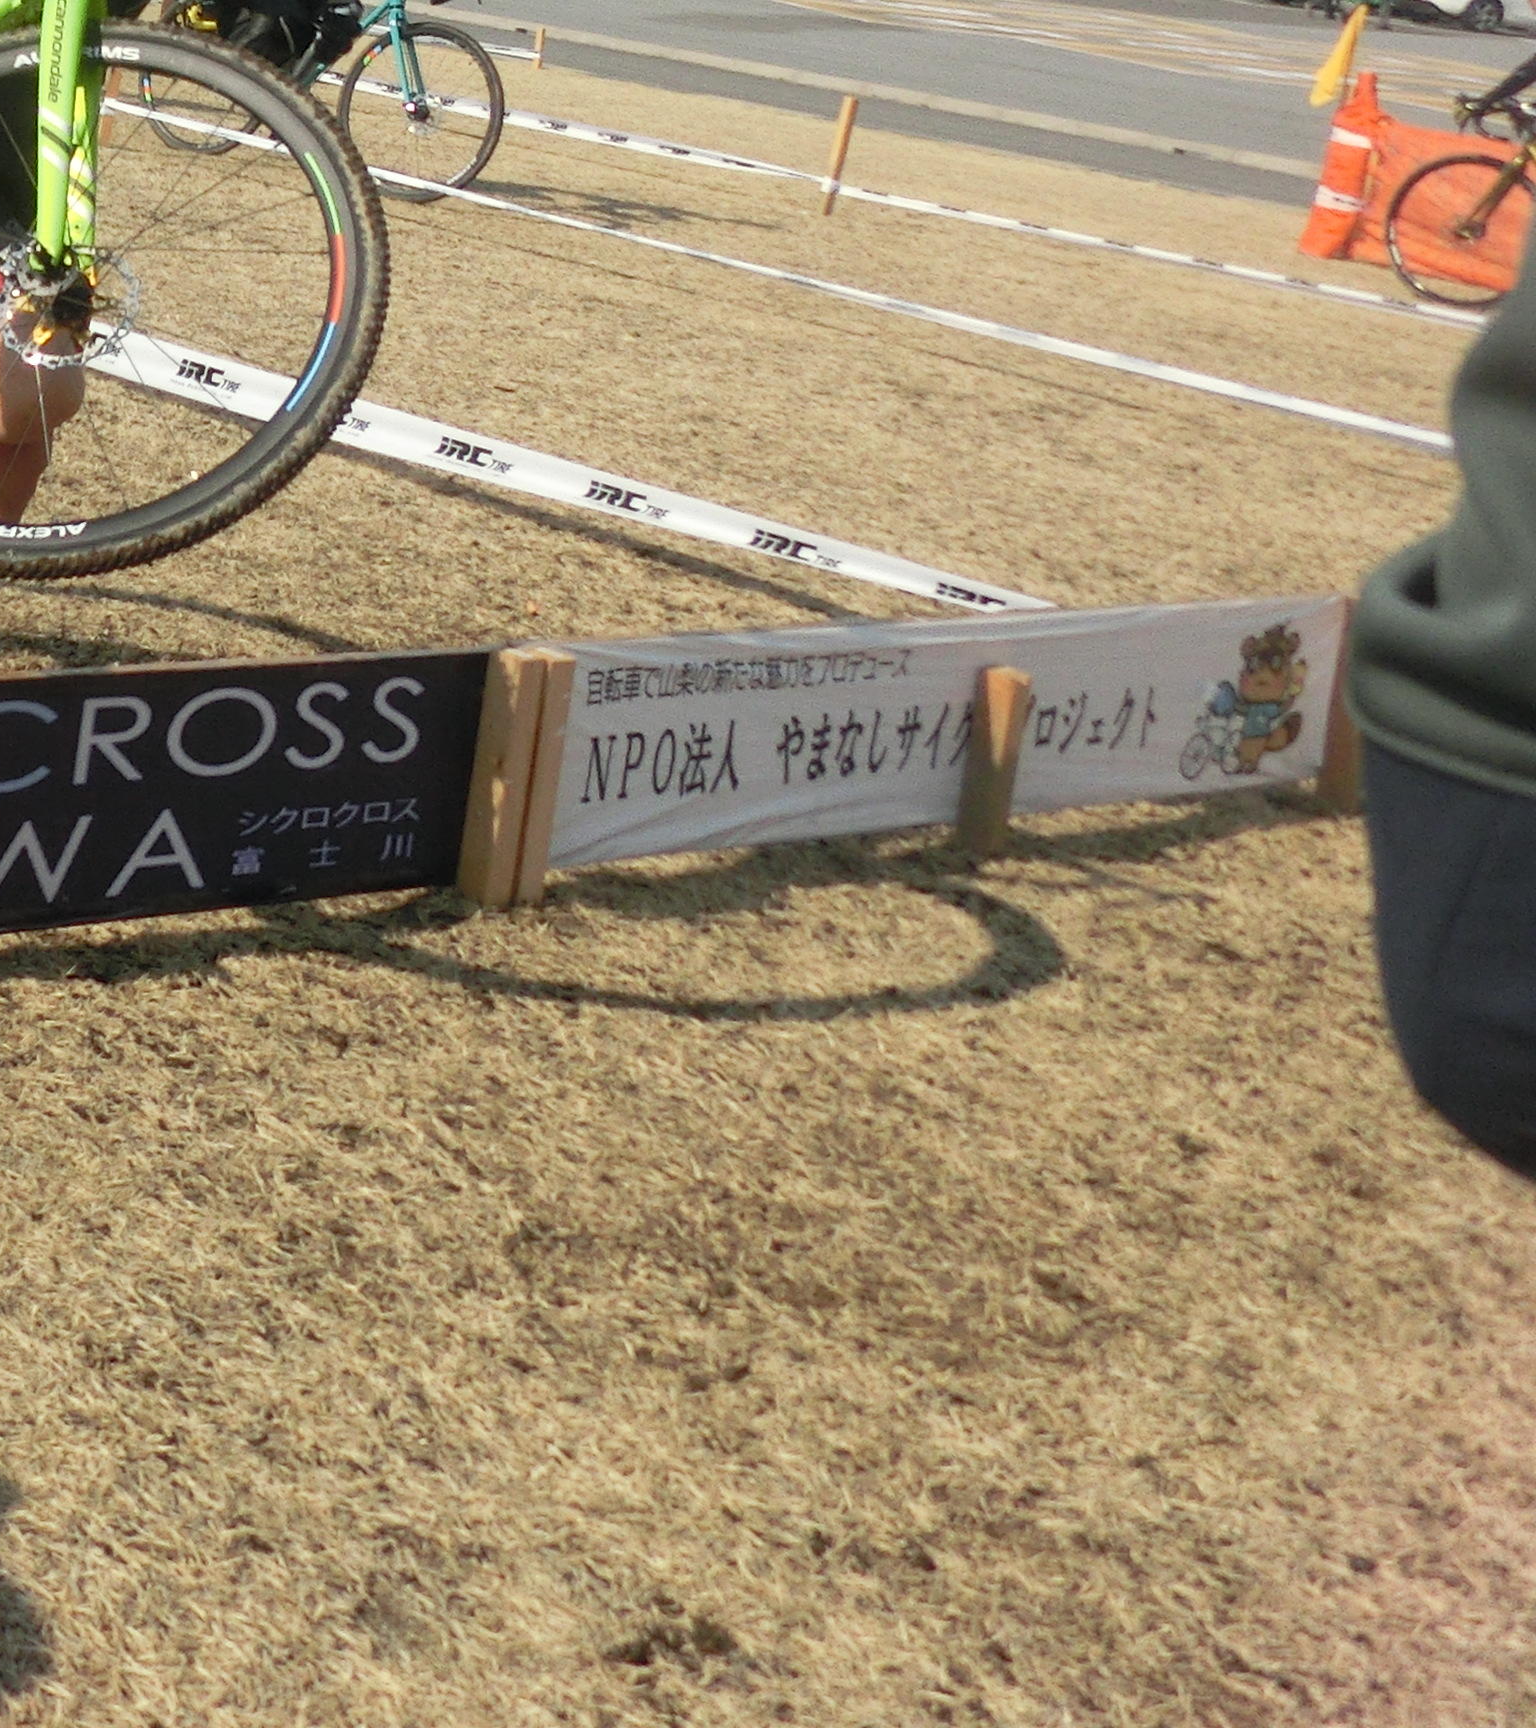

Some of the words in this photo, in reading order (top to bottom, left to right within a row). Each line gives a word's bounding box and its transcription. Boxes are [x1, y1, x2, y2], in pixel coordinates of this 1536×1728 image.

[346, 416, 371, 432] TIRE
[487, 459, 514, 474] TIRE
[580, 719, 739, 804] NPO法人
[776, 686, 1157, 785] やまなしサイクロジェクト
[238, 797, 421, 837] シクロクロス
